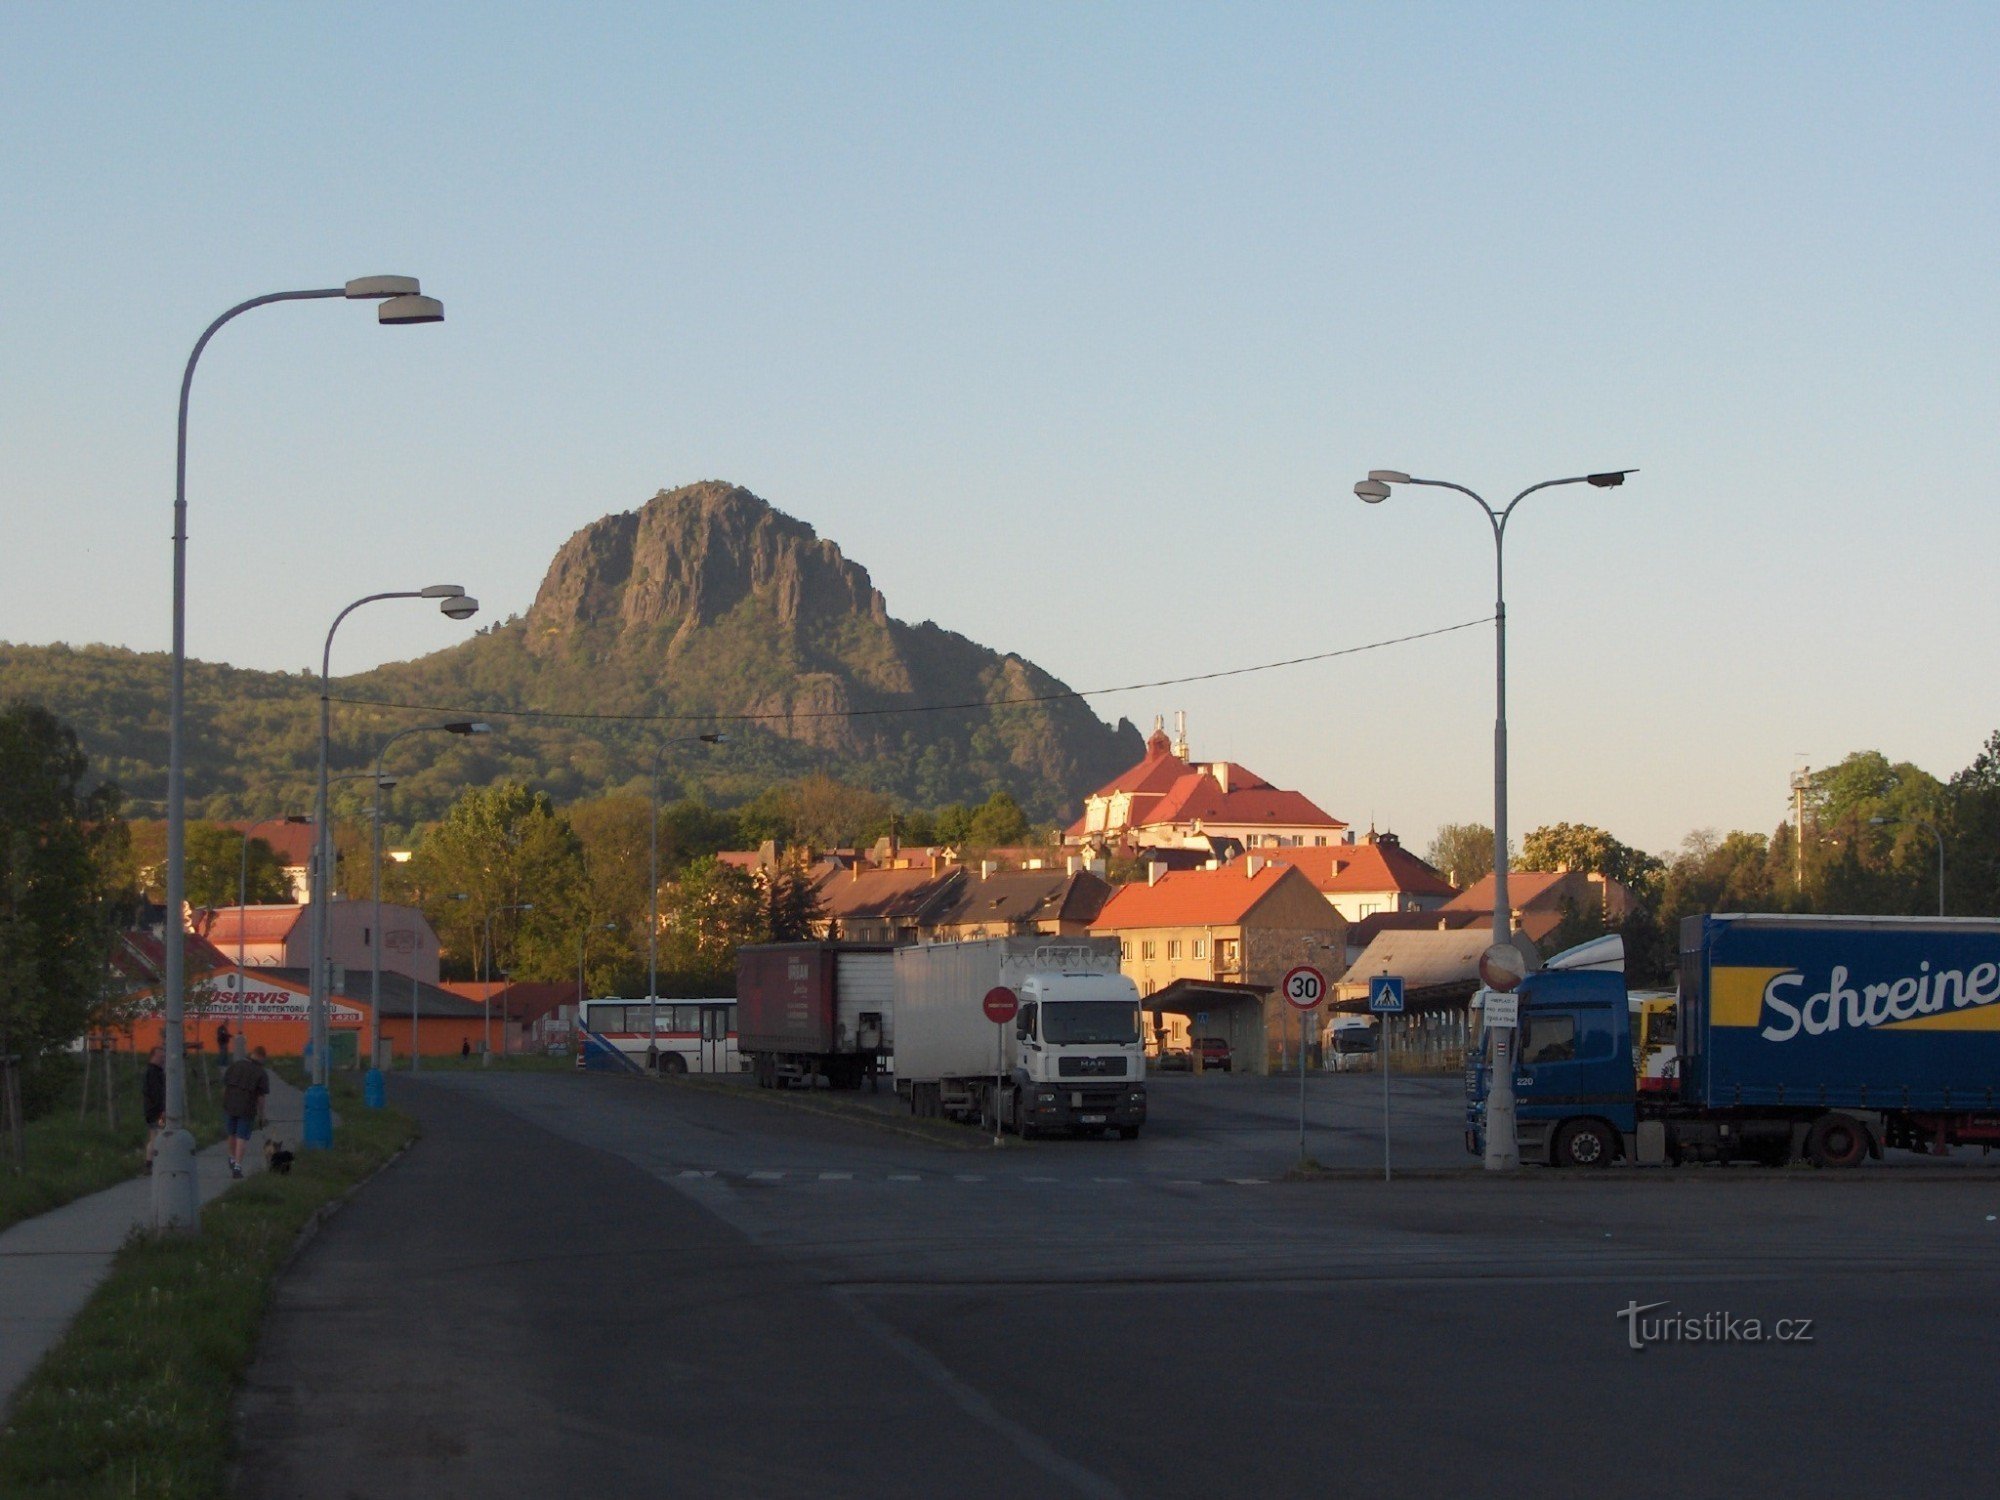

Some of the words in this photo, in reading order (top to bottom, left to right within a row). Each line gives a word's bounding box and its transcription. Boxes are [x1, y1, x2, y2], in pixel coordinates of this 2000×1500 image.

[1292, 977, 1317, 998] 30
[1761, 960, 2000, 1042] Schreine
[1516, 1077, 1534, 1086] 220
